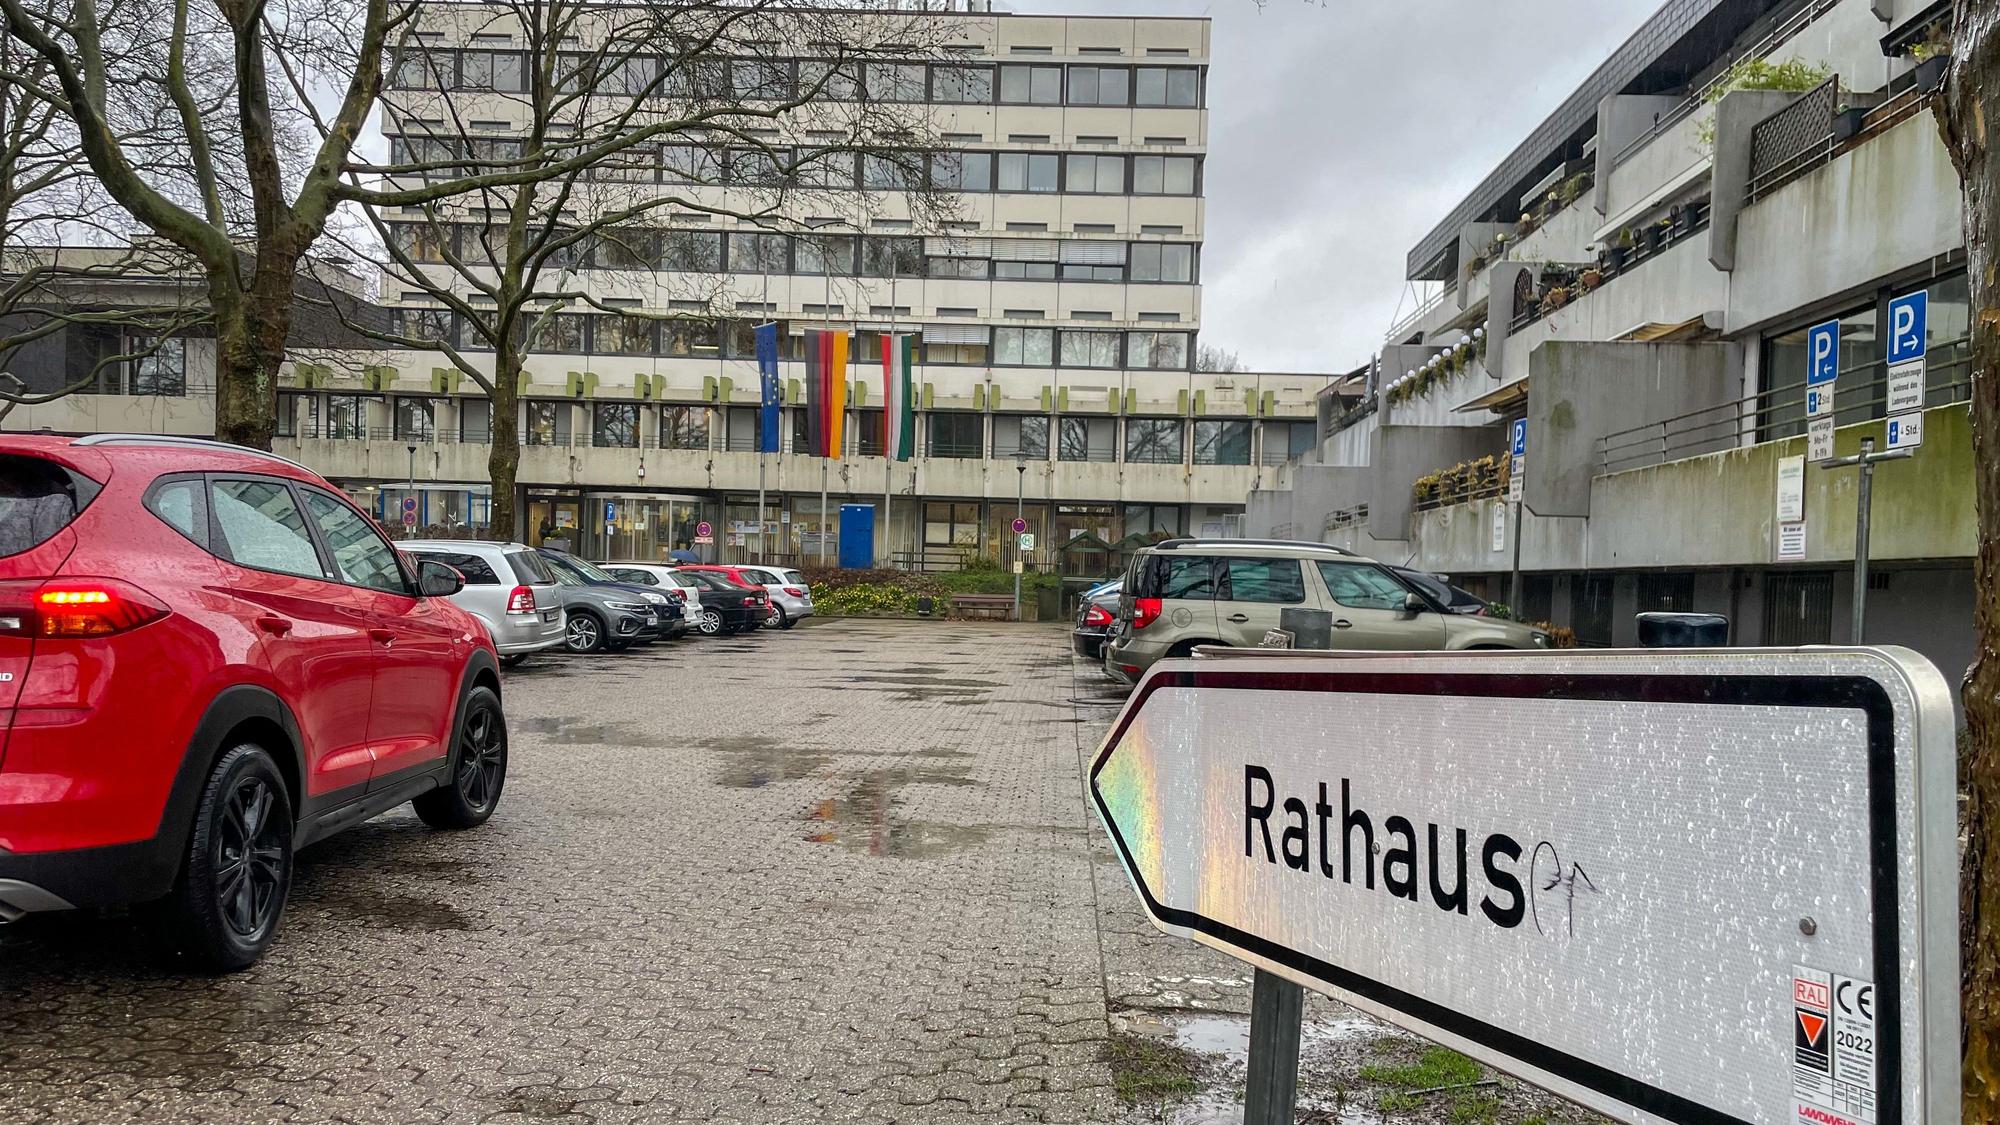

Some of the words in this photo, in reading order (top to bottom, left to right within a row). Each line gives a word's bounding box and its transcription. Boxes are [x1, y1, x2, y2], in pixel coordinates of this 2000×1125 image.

[1893, 304, 1915, 355] P
[1814, 331, 1832, 377] P
[1514, 424, 1523, 452] P
[1245, 764, 1526, 929] Rathaus
[1797, 984, 1825, 1005] RAL
[1836, 980, 1873, 1021] CE
[1836, 1030, 1873, 1055] 2022
